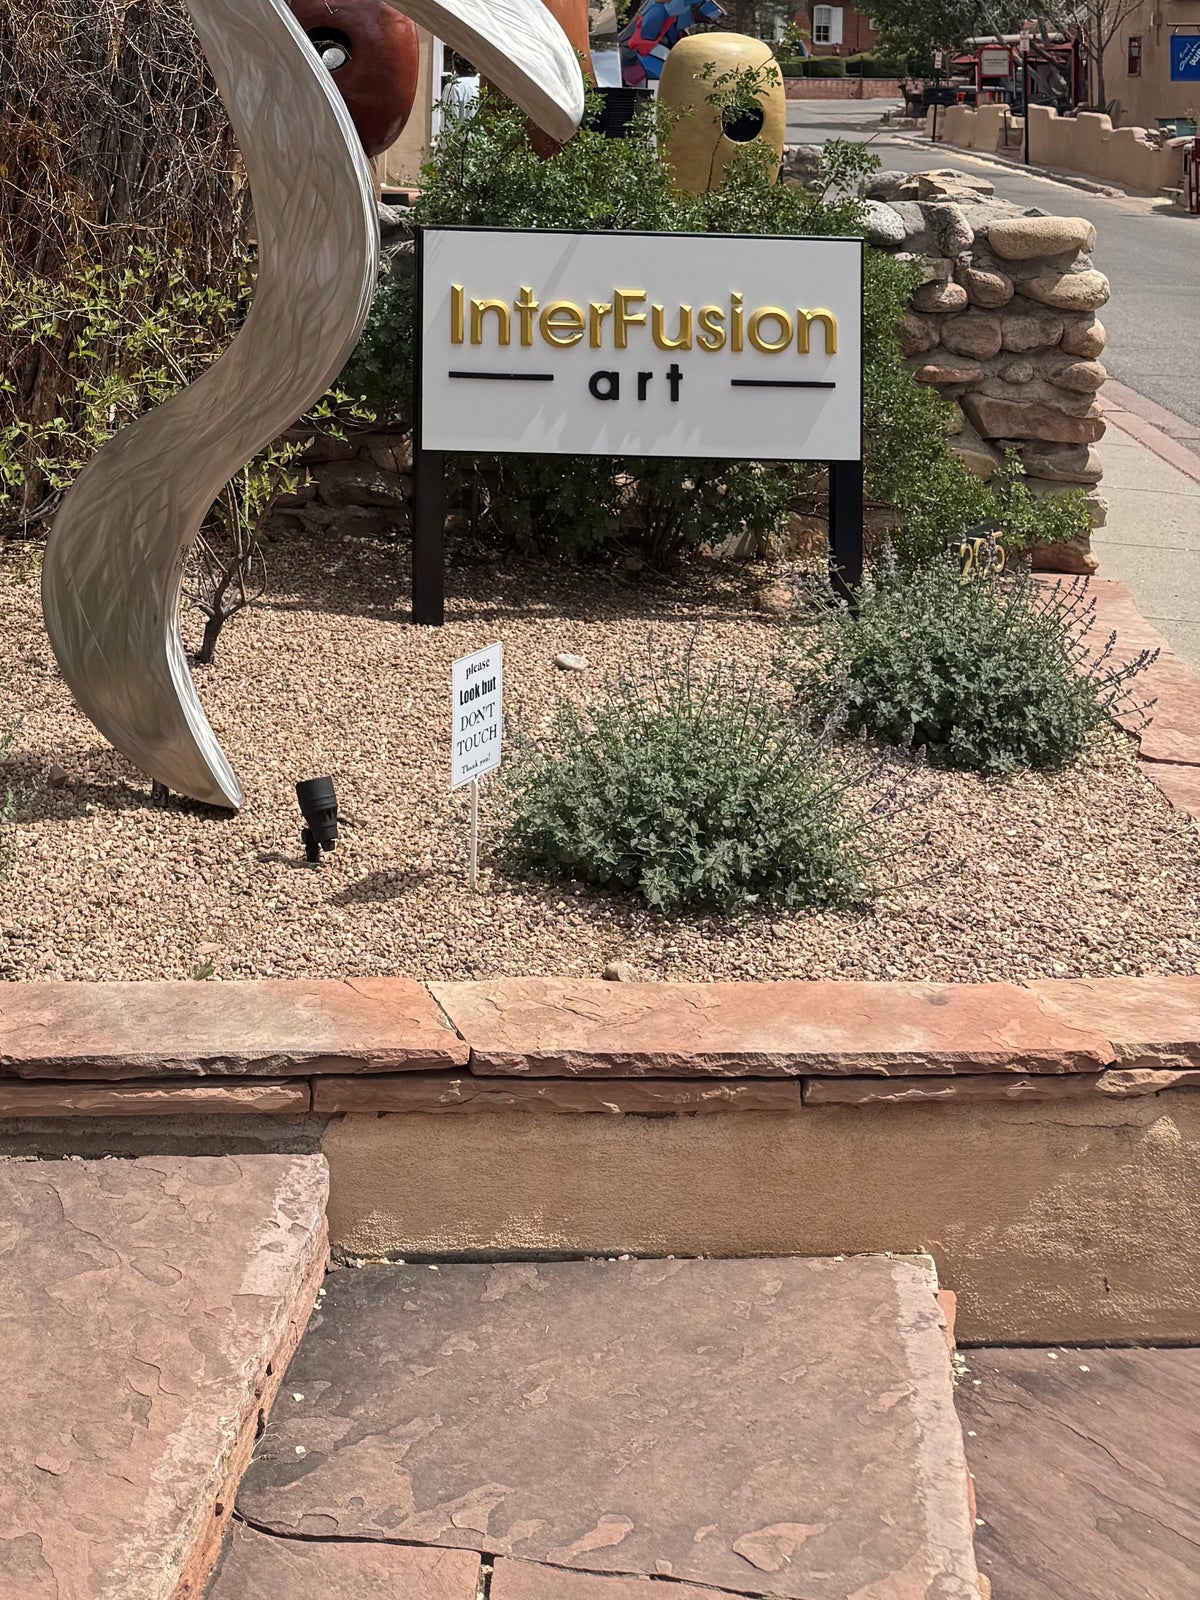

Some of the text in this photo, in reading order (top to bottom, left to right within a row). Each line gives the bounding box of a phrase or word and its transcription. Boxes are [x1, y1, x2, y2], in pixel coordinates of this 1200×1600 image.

[450, 283, 838, 354] InterFusion
[588, 363, 684, 402] art
[465, 658, 491, 680] please
[459, 676, 497, 706] Look but
[460, 701, 496, 732] DON'T
[456, 723, 498, 757] TOUCH
[461, 760, 479, 775] Thank
